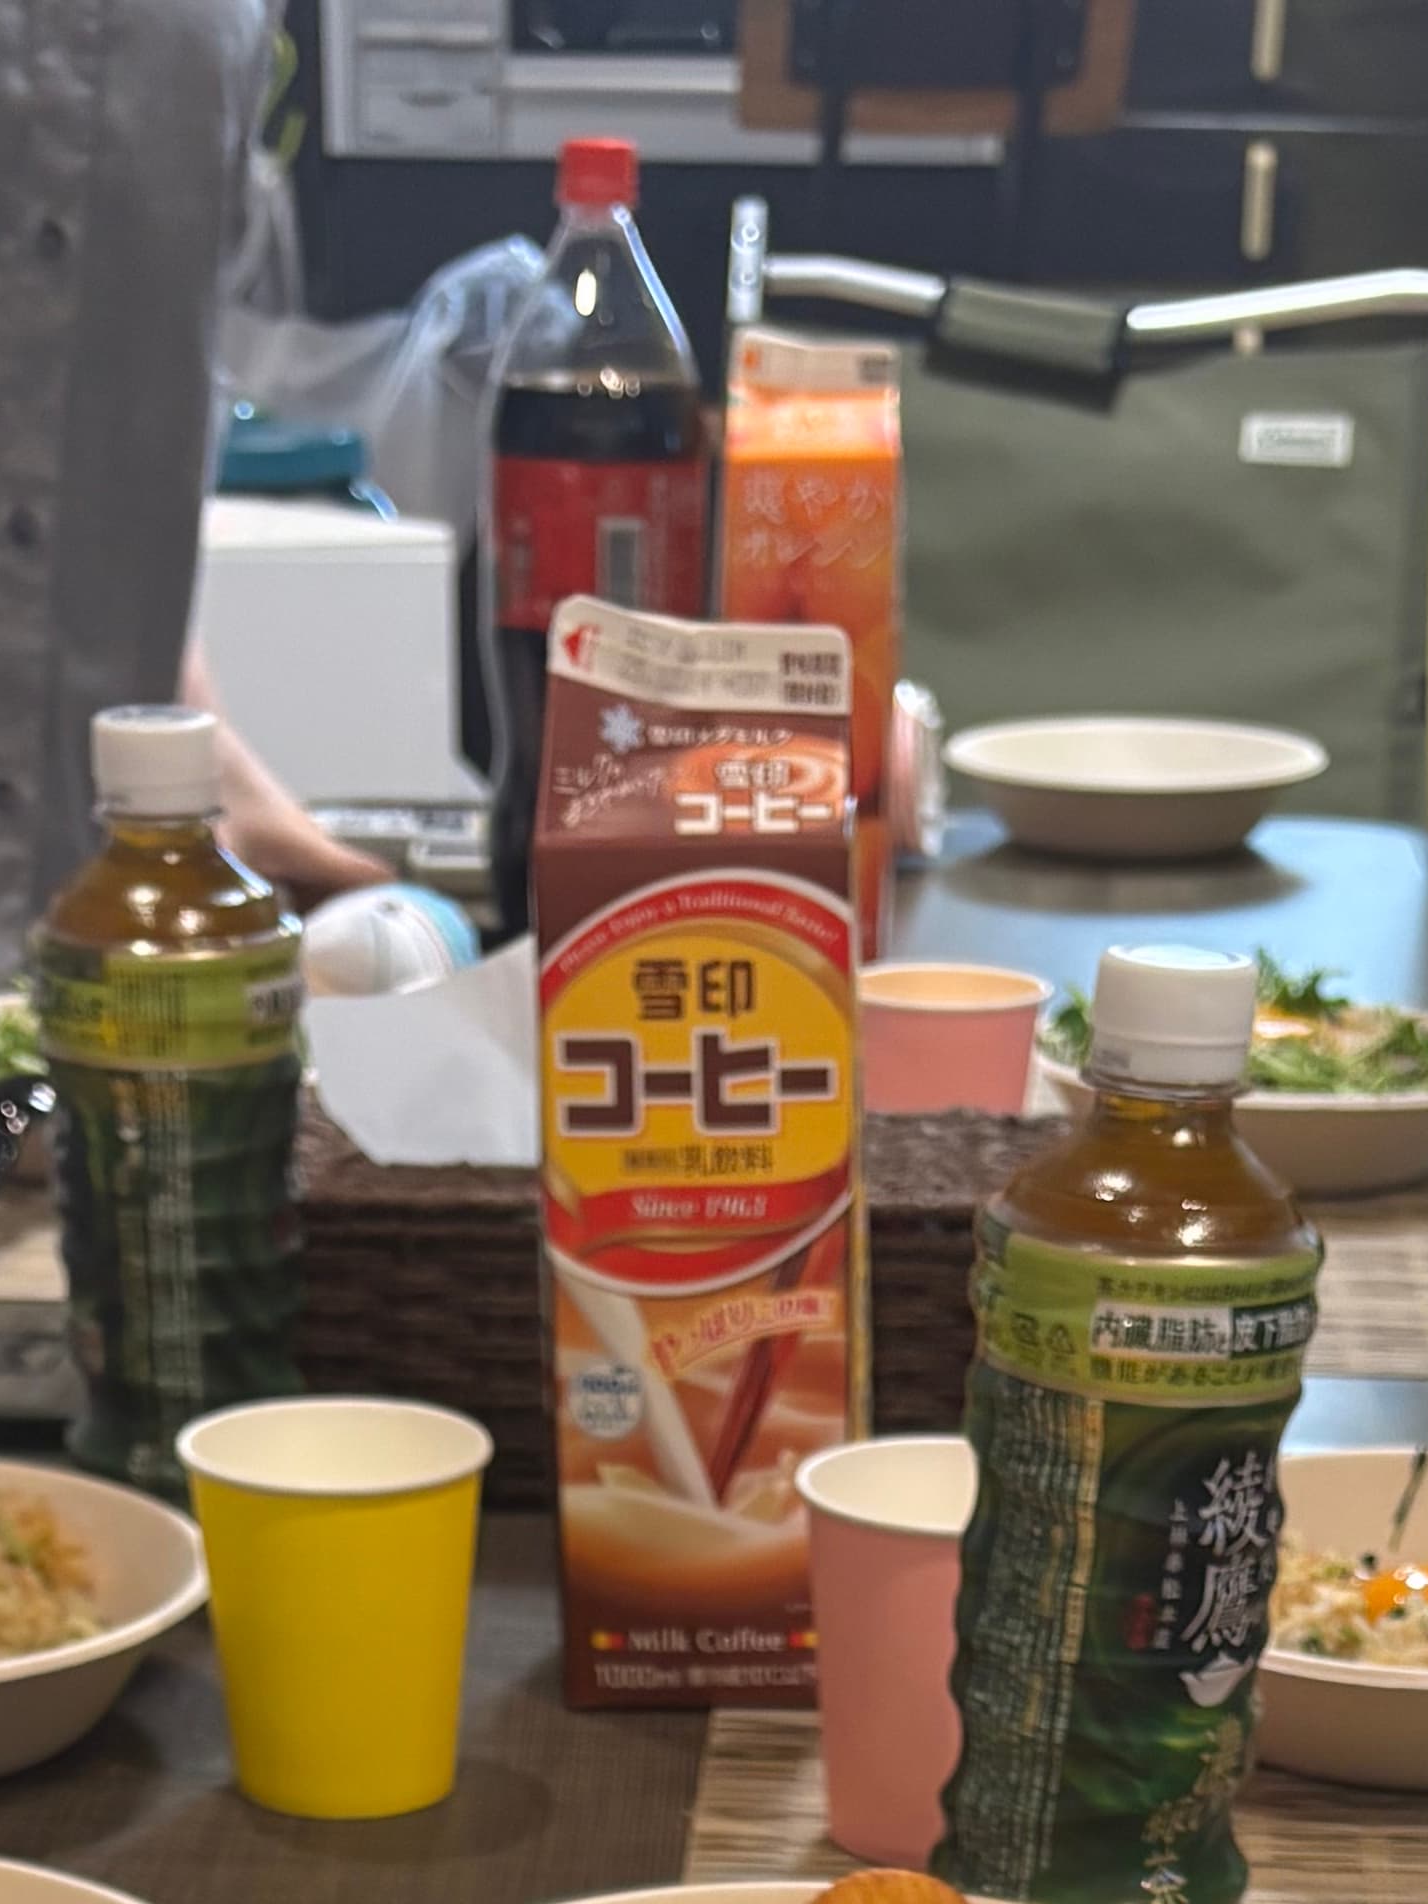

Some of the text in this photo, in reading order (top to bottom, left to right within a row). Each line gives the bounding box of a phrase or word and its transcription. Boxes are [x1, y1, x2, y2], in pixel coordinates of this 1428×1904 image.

[673, 790, 833, 835] コーヒー
[633, 957, 756, 1021] 雪印
[555, 1029, 836, 1135] コーヒー
